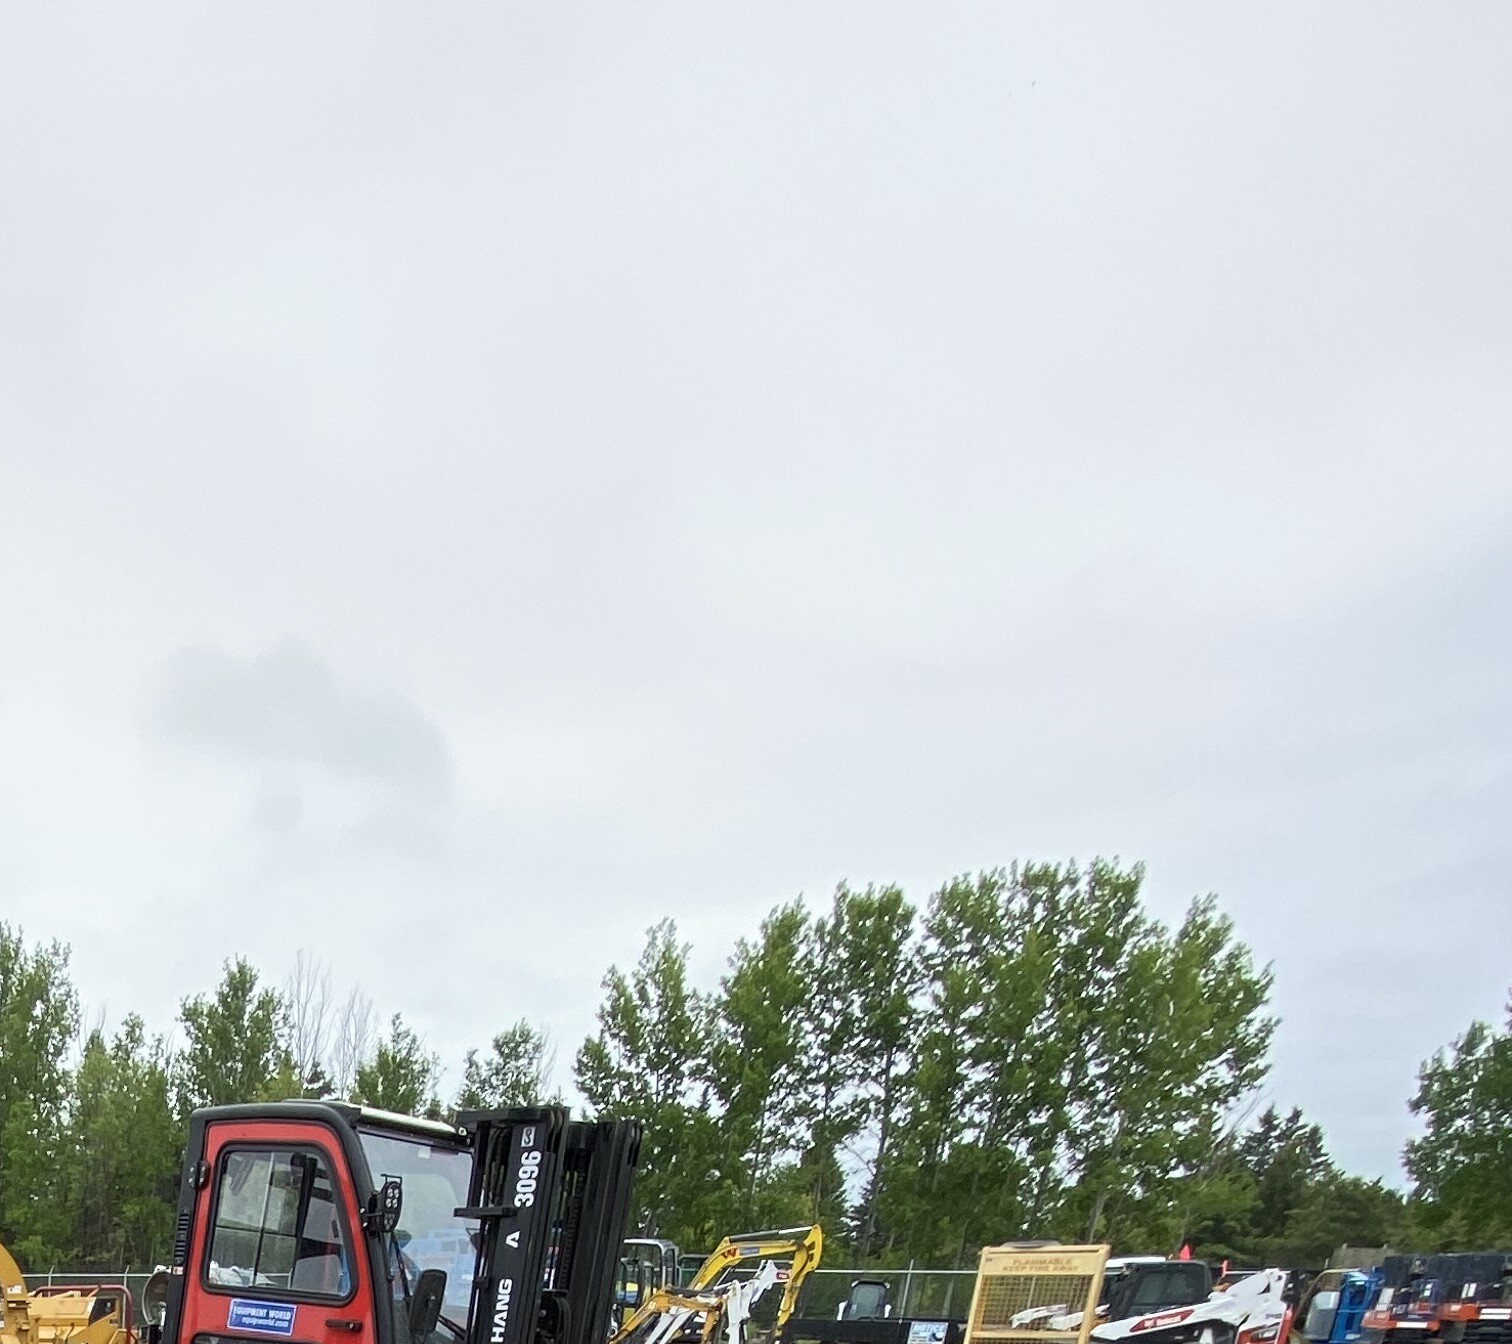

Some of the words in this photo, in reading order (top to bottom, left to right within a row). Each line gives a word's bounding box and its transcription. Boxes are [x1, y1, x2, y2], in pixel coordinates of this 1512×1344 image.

[514, 1150, 542, 1208] 3096
[505, 1230, 520, 1249] A
[490, 1278, 513, 1344] HANG
